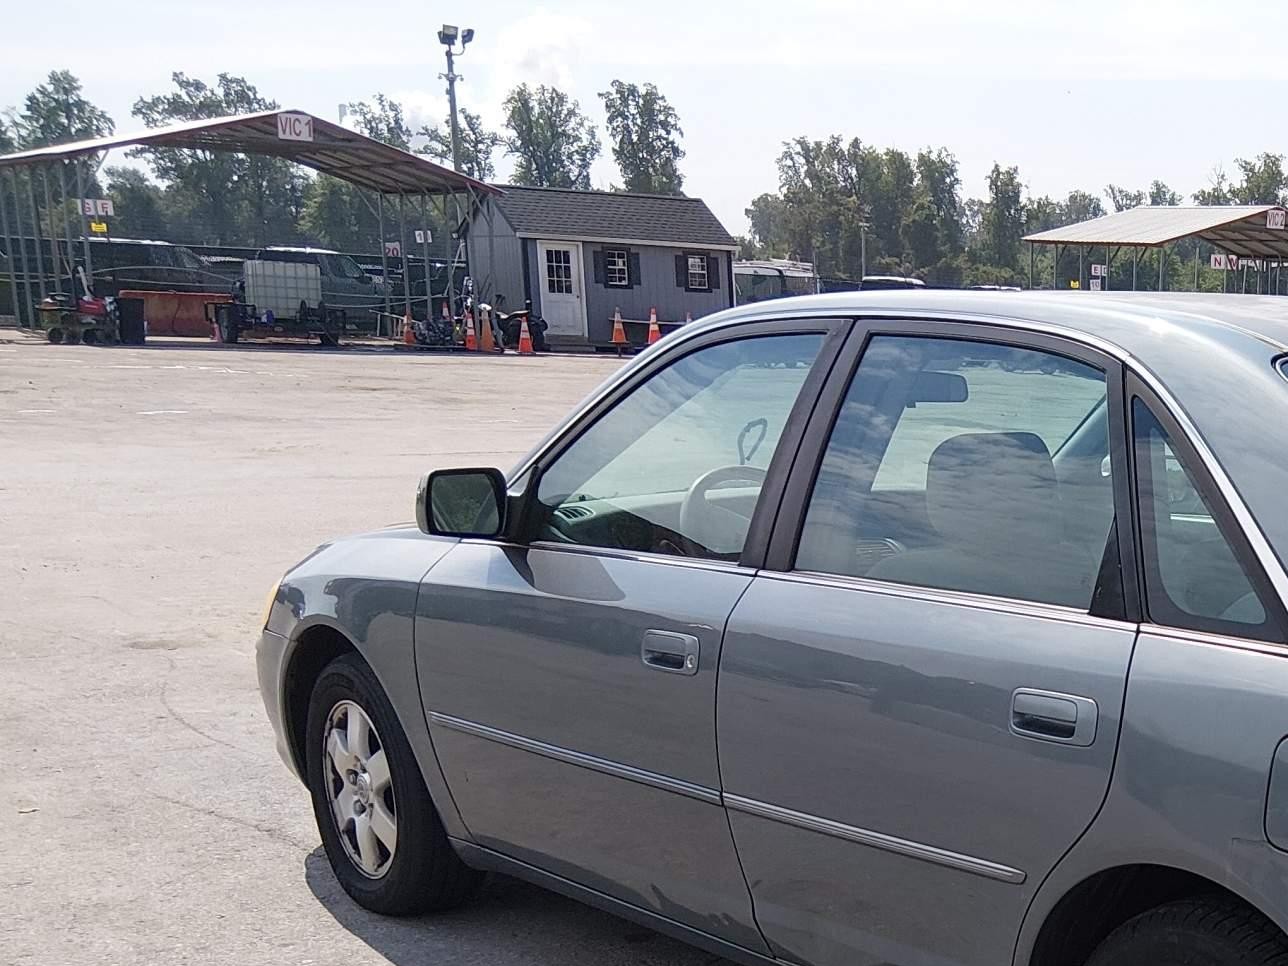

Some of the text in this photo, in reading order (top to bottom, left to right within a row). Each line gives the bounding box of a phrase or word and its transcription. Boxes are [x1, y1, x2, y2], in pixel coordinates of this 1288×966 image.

[278, 115, 313, 138] VIC 1
[101, 202, 109, 213] F
[1267, 213, 1285, 227] VIC 2
[1214, 256, 1222, 267] N
